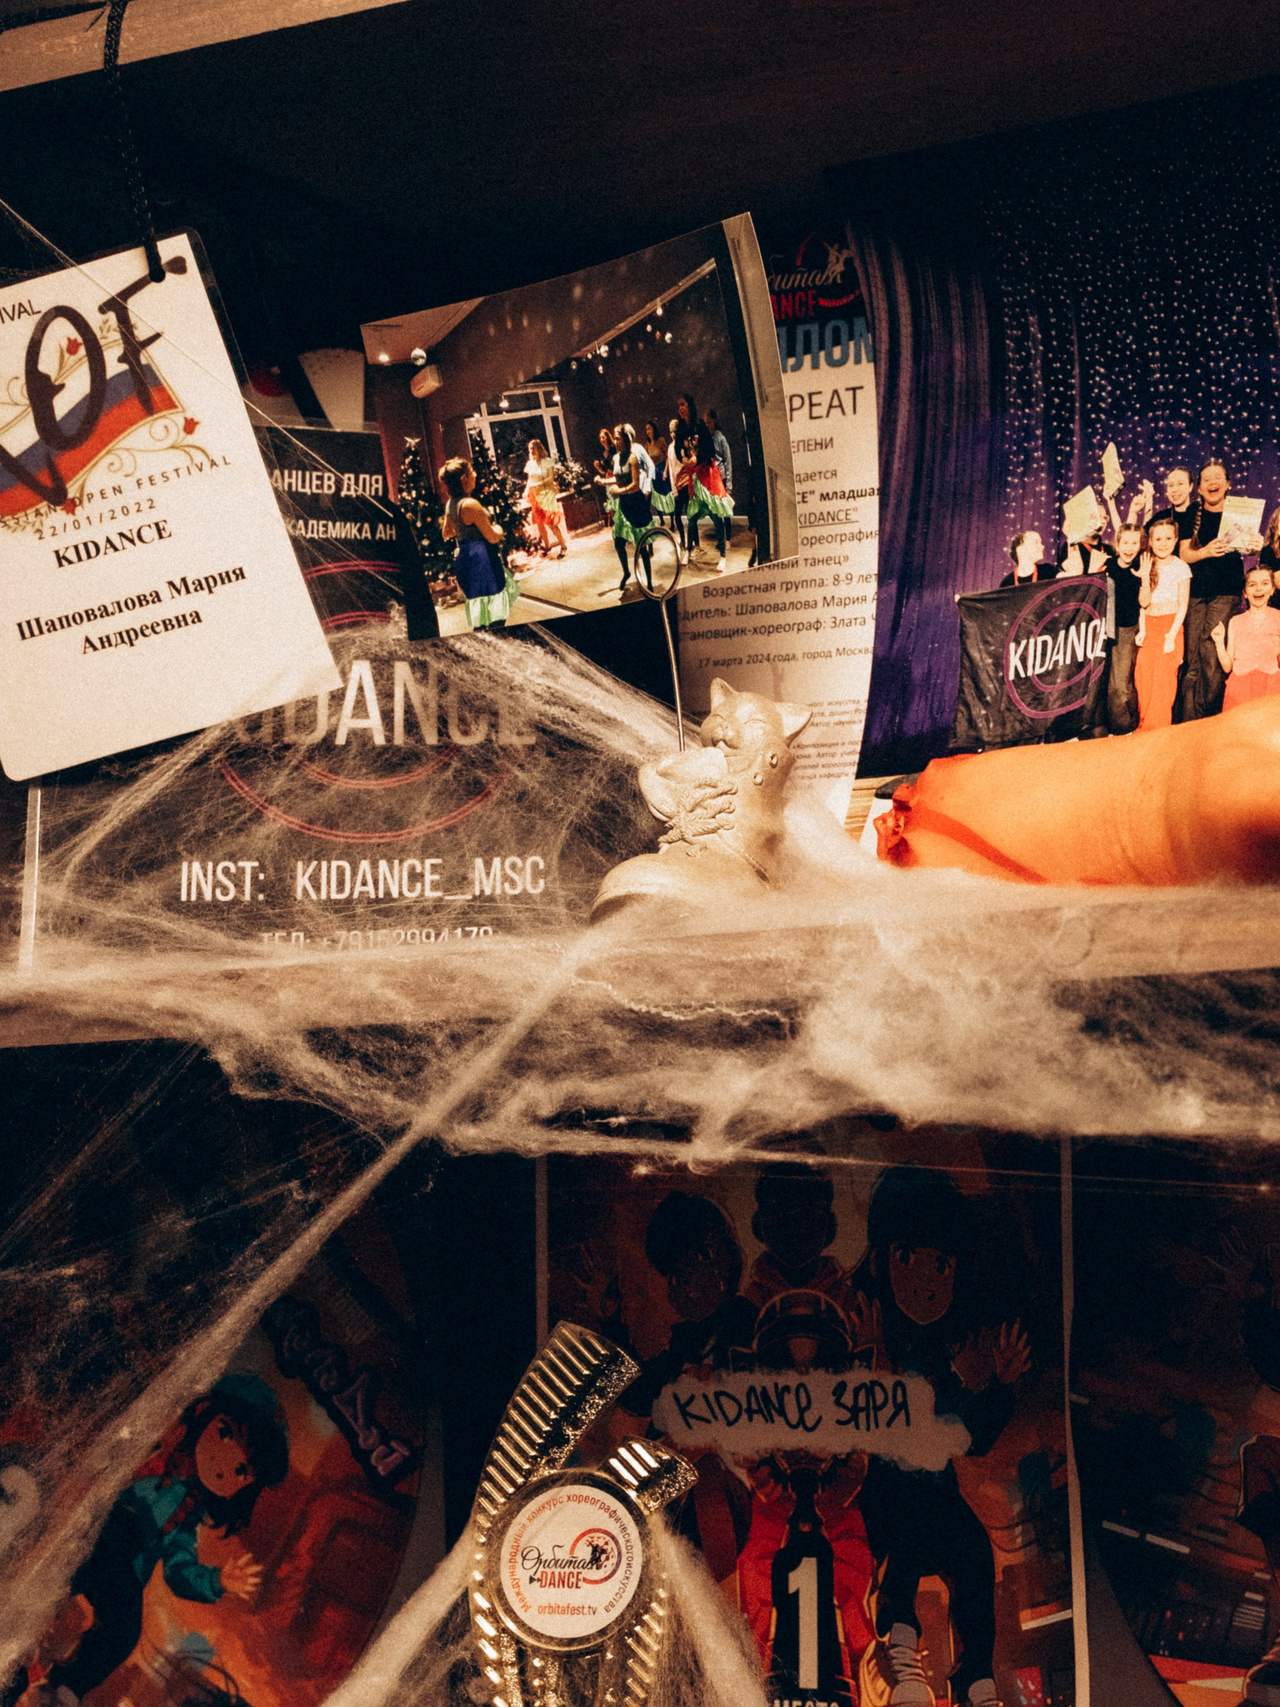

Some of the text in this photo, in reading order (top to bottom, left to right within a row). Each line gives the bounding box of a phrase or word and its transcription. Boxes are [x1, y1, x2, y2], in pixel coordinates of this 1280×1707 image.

[136, 455, 232, 489] FESTIVAL
[340, 473, 383, 498] ДЛЯ
[33, 498, 157, 540] 22/01/2022
[375, 523, 397, 540] АН
[53, 519, 173, 568] KIDANCE
[803, 554, 850, 569] танец»
[703, 581, 776, 600] Возрастная
[780, 577, 829, 593] группа:
[832, 573, 853, 587] 8-9
[15, 566, 248, 641] Шаповалова Мария
[735, 597, 818, 617] Шаповалова
[822, 594, 867, 609] Мария
[82, 609, 204, 655] Андреевна
[830, 616, 867, 629] Злата
[713, 656, 743, 669] марта
[746, 653, 771, 665] 2024
[773, 651, 799, 663] года,
[802, 649, 832, 661] город
[1008, 617, 1107, 681] KIDANCE
[180, 855, 545, 902] INST: KIDANCE_MSC
[831, 1380, 911, 1432] ЗАРЯ
[526, 1494, 565, 1523] конкурс
[539, 1570, 583, 1589] DANCE
[537, 1602, 598, 1616] orbitafest.tv
[787, 1557, 819, 1690] 1
